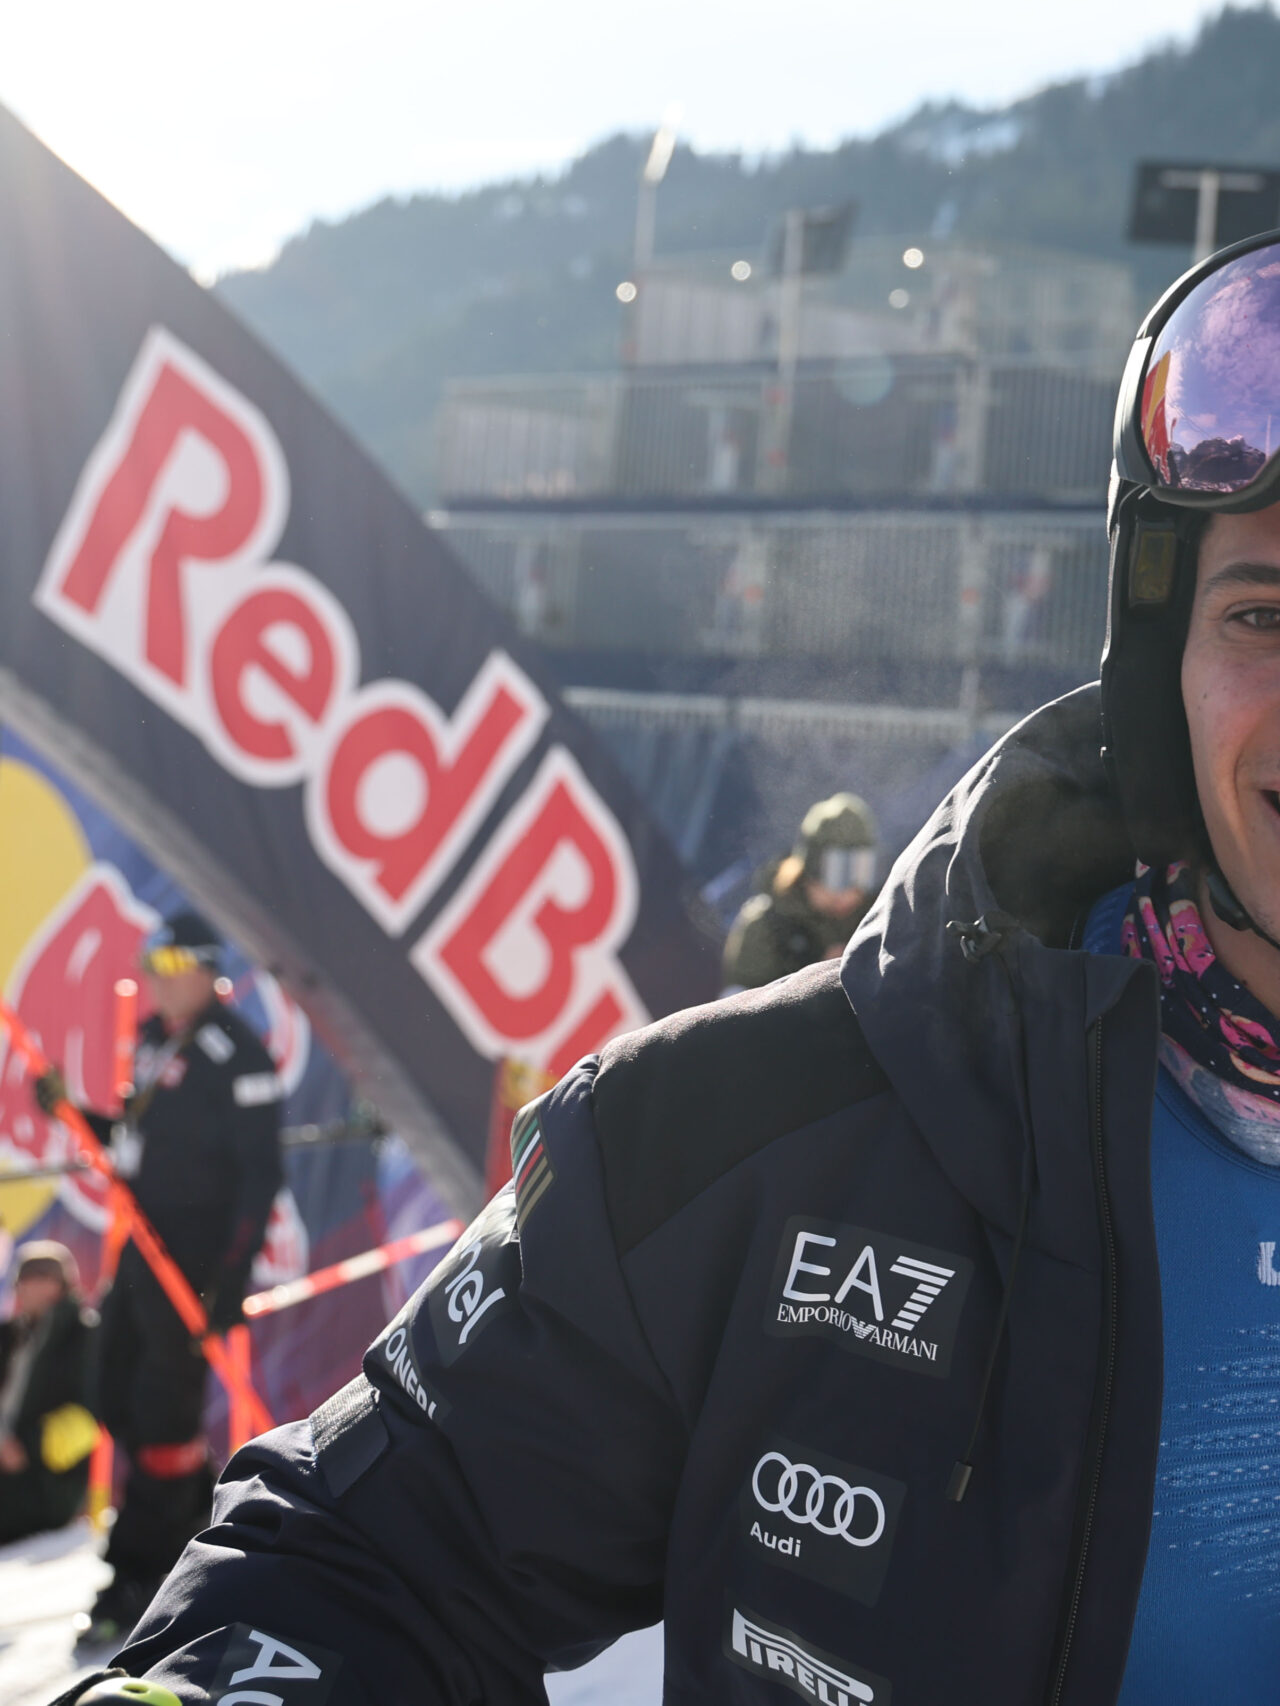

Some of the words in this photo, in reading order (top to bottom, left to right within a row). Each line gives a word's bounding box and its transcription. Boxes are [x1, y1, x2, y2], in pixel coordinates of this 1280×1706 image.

[35, 323, 551, 937] Red
[444, 1240, 506, 1345] nel
[782, 1231, 956, 1331] EA7
[776, 1302, 851, 1332] EMPORIO
[868, 1326, 939, 1361] ARMANI
[750, 1521, 801, 1558] Audi
[732, 1607, 874, 1706] PIREL
